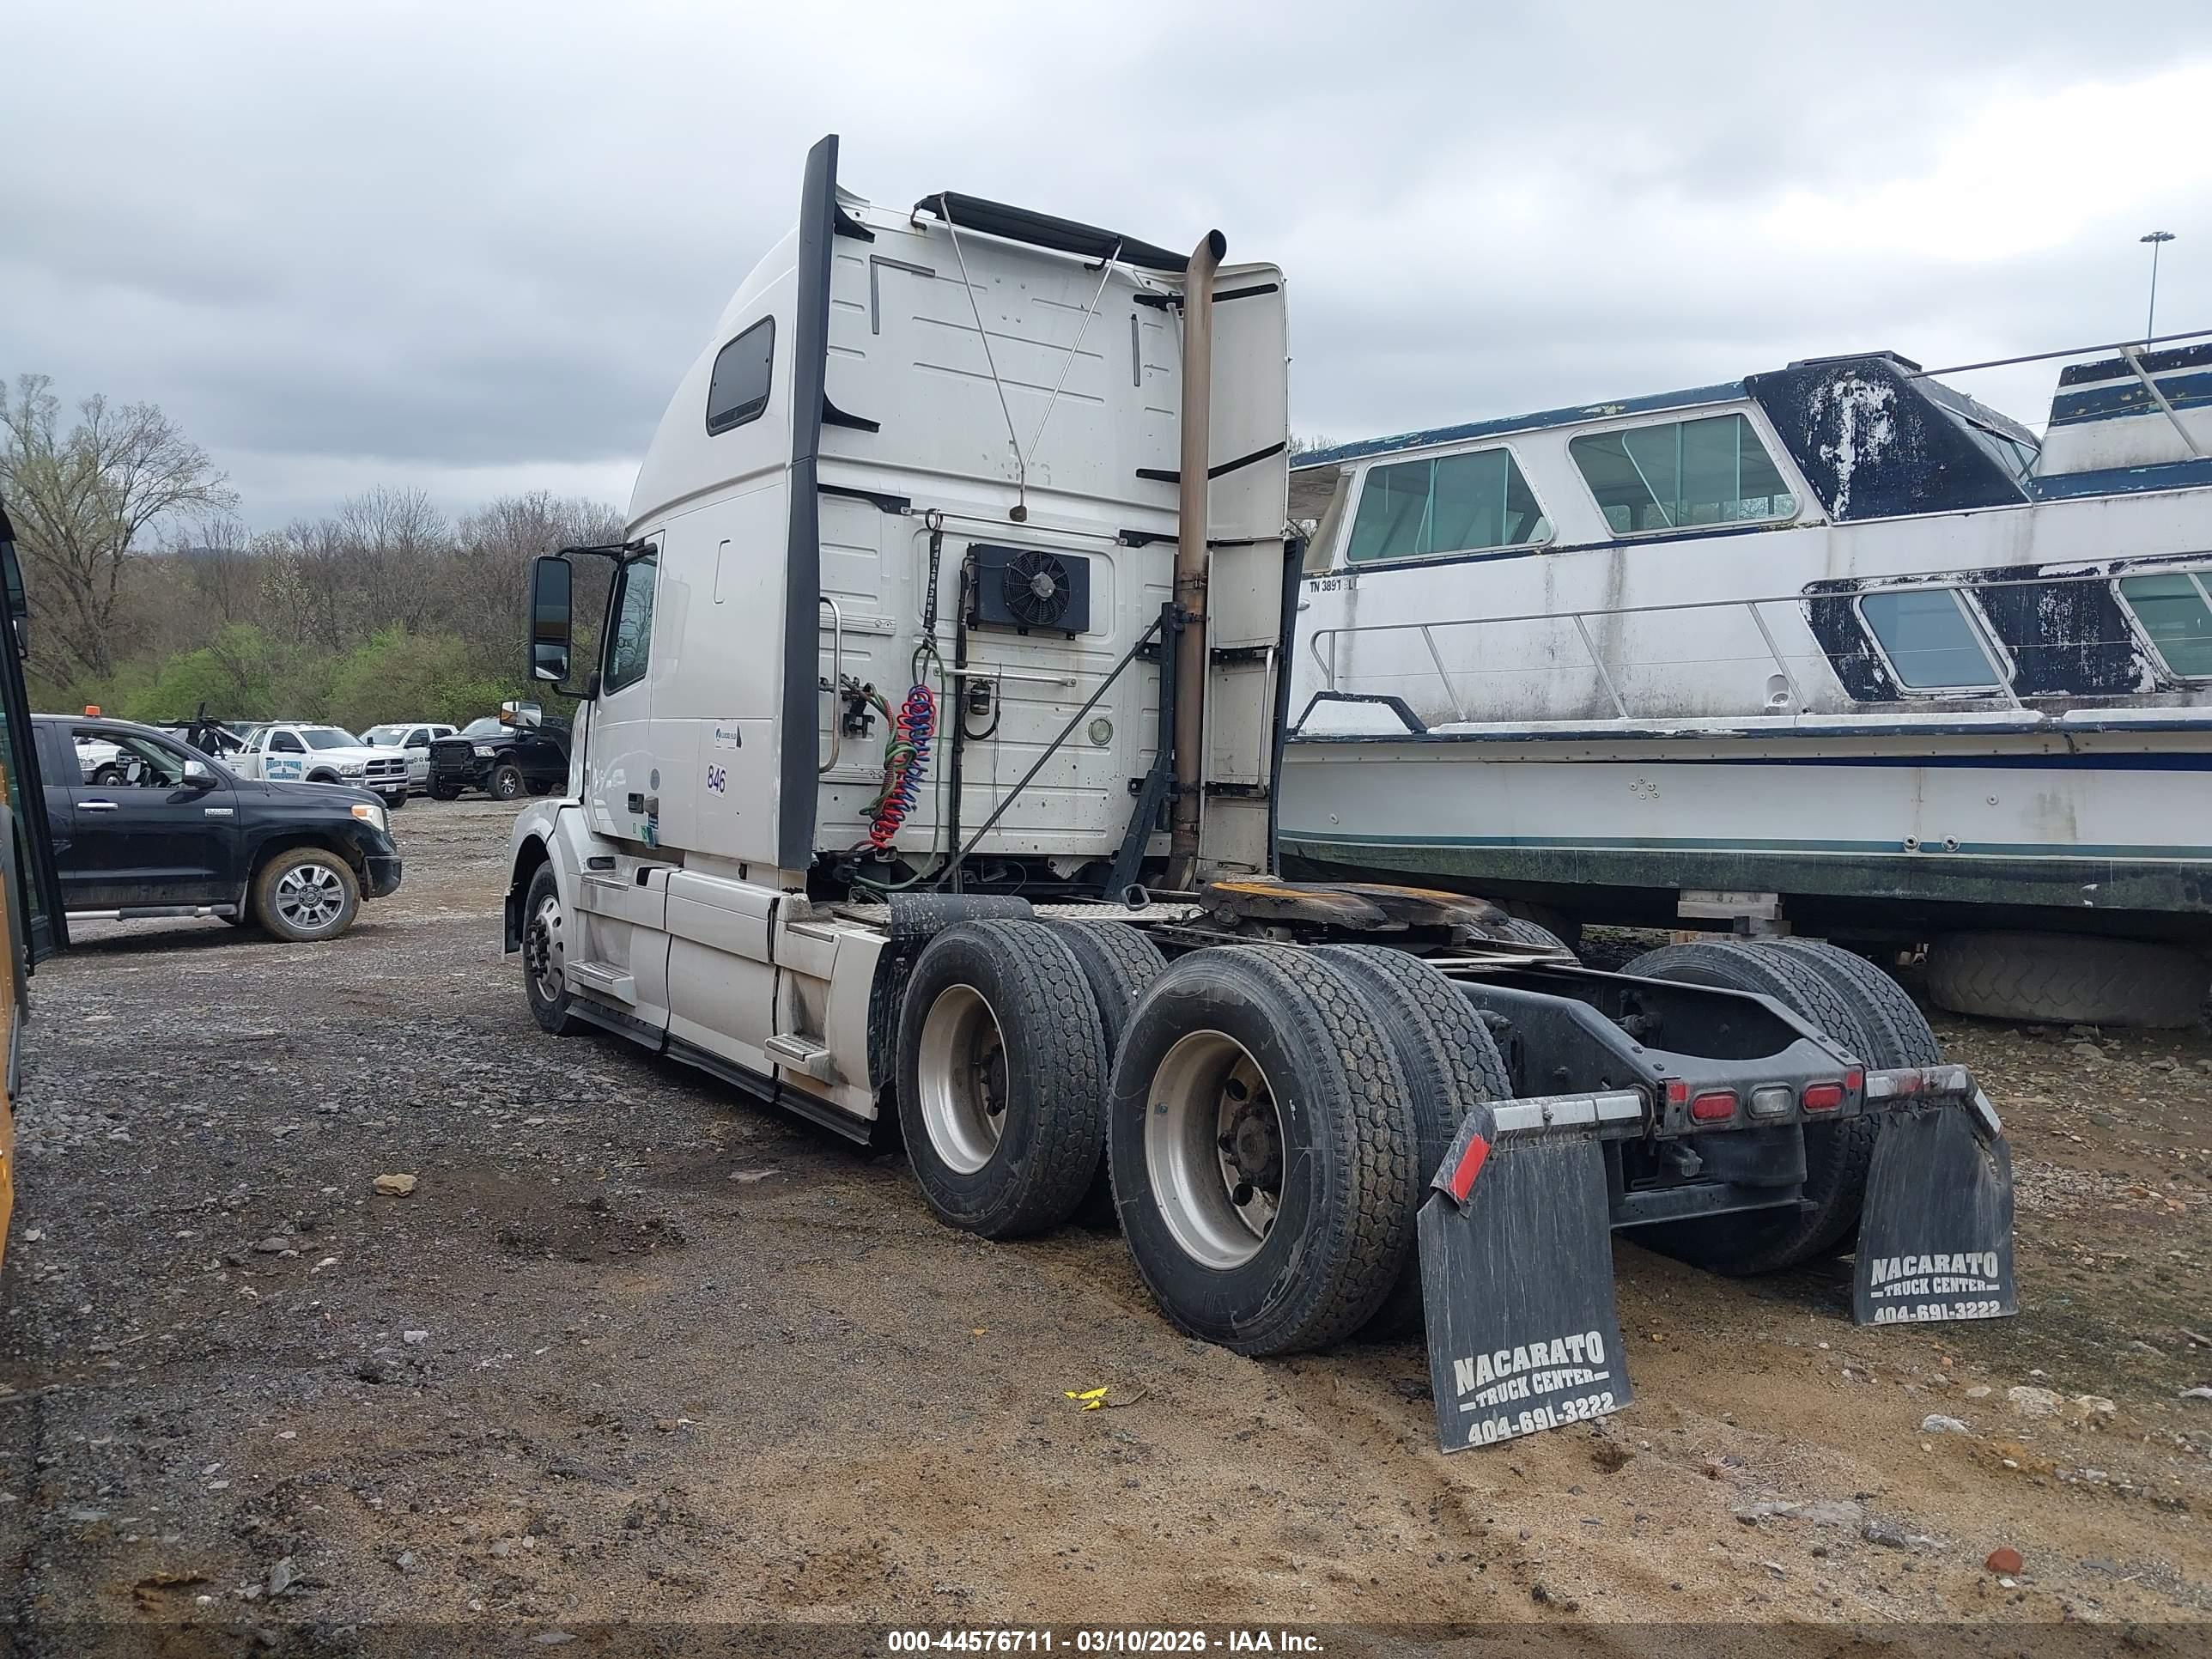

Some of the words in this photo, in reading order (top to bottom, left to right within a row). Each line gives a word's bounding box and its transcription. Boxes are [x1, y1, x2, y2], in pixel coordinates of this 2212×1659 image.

[1310, 581, 1320, 592] TN
[708, 765, 726, 793] 846
[1871, 1251, 1998, 1286] NACARATO
[1884, 1279, 1929, 1298] TRUCK
[1933, 1277, 1986, 1294] CENTER
[1874, 1300, 2001, 1322] 404-691-3222
[1454, 1330, 1605, 1397] NACARATO
[1475, 1376, 1530, 1408] TRUCK
[1532, 1369, 1595, 1395] CENTER
[1468, 1391, 1615, 1445] 404-691-3222
